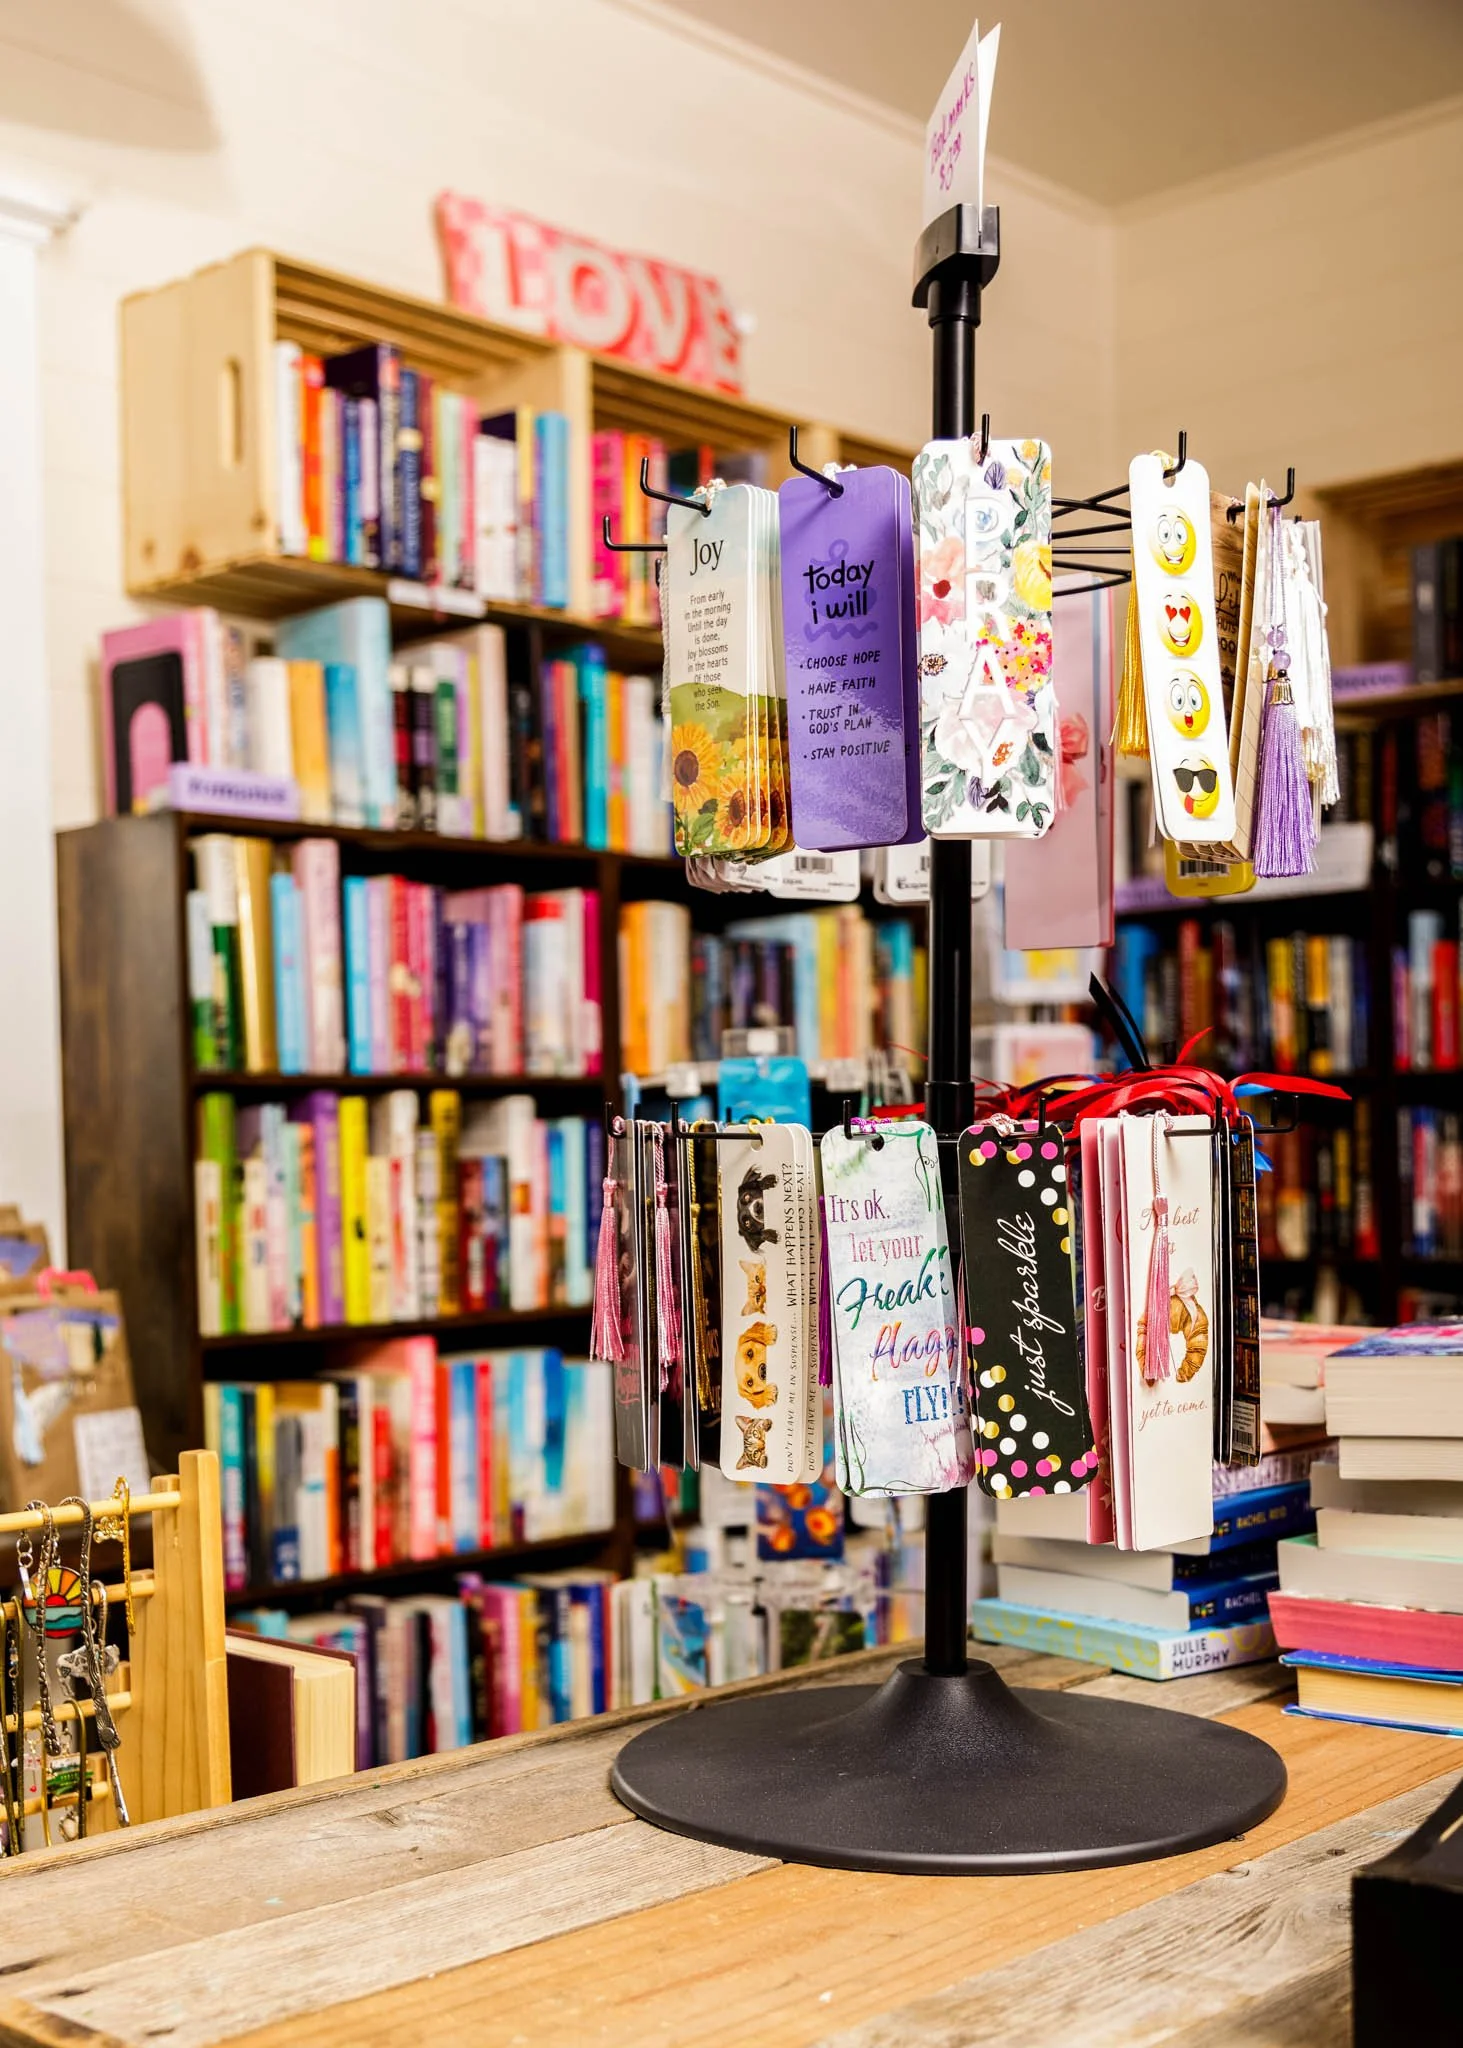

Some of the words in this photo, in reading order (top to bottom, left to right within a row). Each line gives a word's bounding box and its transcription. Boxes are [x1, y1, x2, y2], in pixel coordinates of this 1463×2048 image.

[475, 220, 743, 385] LOVE
[689, 538, 724, 576] Joy
[802, 559, 875, 594] today
[690, 594, 707, 605] From
[708, 589, 725, 602] early
[811, 600, 819, 624] i
[826, 590, 868, 620] will
[684, 610, 691, 620] in
[692, 607, 702, 619] the
[704, 602, 732, 615] morning
[687, 620, 702, 632] Until
[703, 618, 714, 630] the
[716, 616, 728, 629] day
[694, 633, 701, 645] is
[960, 497, 1016, 783] PRAY
[687, 648, 697, 661] Joy
[698, 644, 729, 658] blossoms
[807, 654, 848, 670] CHOOSE
[853, 650, 882, 665] HOPE
[687, 661, 694, 673] in
[695, 661, 705, 672] the
[707, 656, 729, 669] hearts
[703, 671, 721, 683] those
[807, 681, 837, 696] HAVE
[842, 676, 877, 691] FAITH
[693, 687, 706, 698] who
[707, 684, 723, 697] seek
[695, 700, 705, 712] the
[809, 705, 842, 721] TRUST
[848, 704, 860, 717] IN
[809, 720, 839, 735] GOD'S
[844, 716, 873, 731] PLAN
[810, 747, 836, 761] STAY
[841, 740, 891, 758] POSITIVE
[782, 1162, 793, 1203] NEXT?
[829, 1194, 860, 1223] It's
[864, 1188, 891, 1220] ok.
[1173, 1205, 1200, 1226] best
[784, 1206, 796, 1266] HAPPENS
[849, 1232, 876, 1263] let
[880, 1233, 924, 1267] your
[996, 1211, 1067, 1335] sparkle
[786, 1271, 798, 1307] WHAT
[836, 1248, 937, 1330] Freak
[789, 1374, 797, 1386] IN
[809, 1374, 818, 1385] IN
[1010, 1327, 1075, 1417] just
[788, 1391, 797, 1405] ME
[808, 1390, 817, 1404] ME
[902, 1384, 948, 1425] FLY!
[787, 1409, 795, 1437] LEAVE
[807, 1407, 817, 1437] LEAVE
[1138, 1400, 1161, 1432] yet
[1162, 1399, 1176, 1417] to
[1177, 1400, 1208, 1414] come.
[784, 1441, 795, 1473] DON'T
[805, 1441, 816, 1471] DON'T
[1236, 1511, 1267, 1530] RACHEL
[1224, 1591, 1262, 1610] RACHEL
[1172, 1637, 1208, 1657] JULIE
[1172, 1648, 1230, 1673] MURPHY
